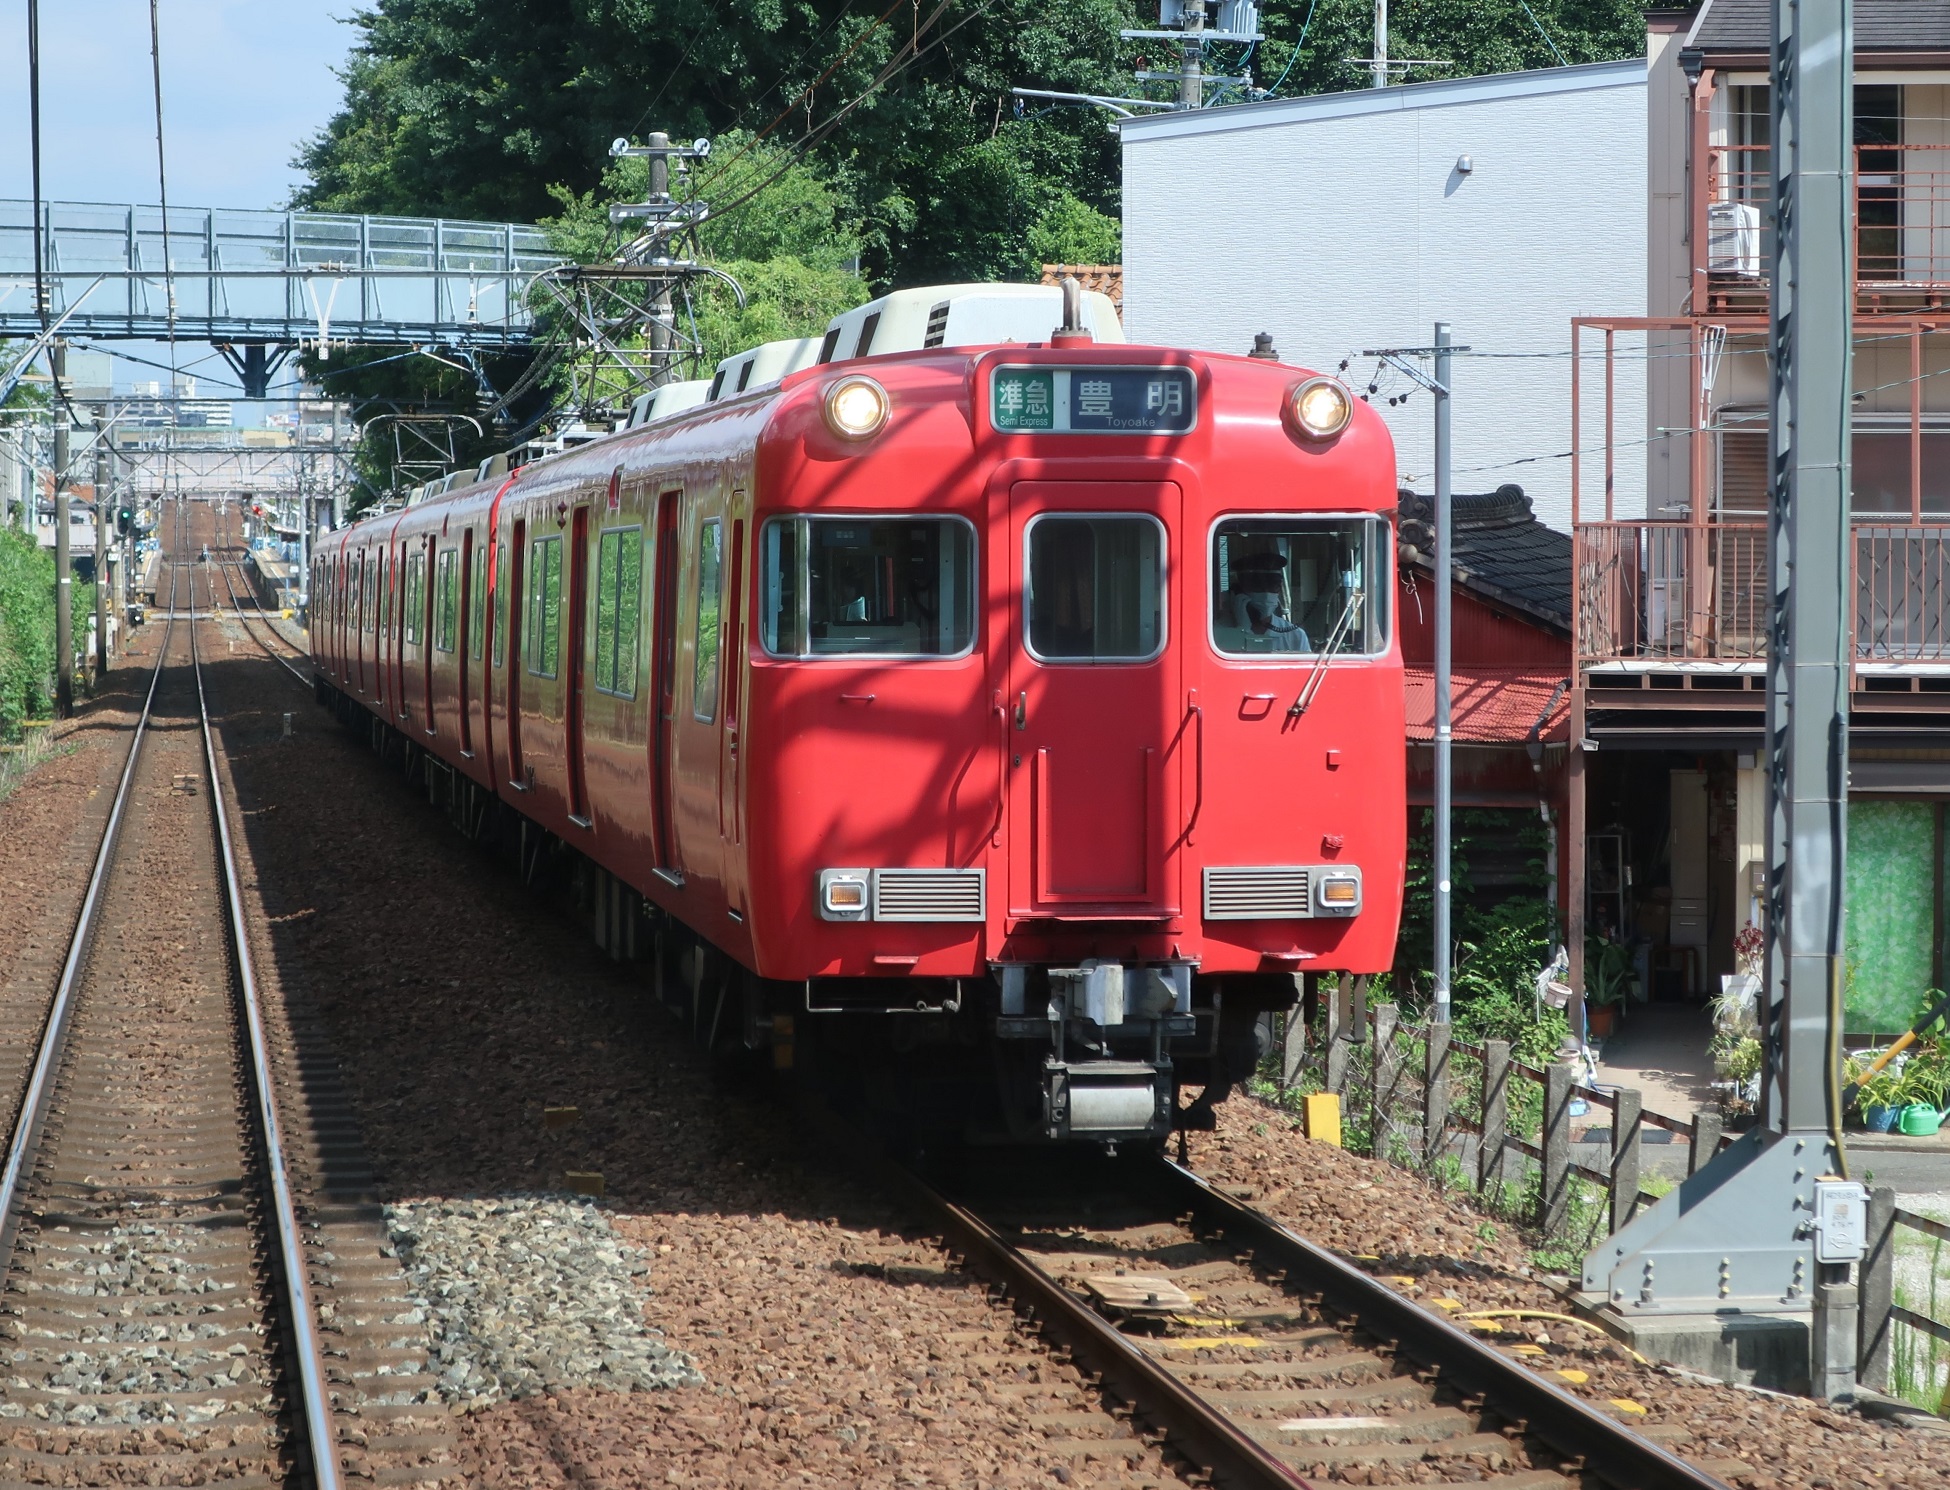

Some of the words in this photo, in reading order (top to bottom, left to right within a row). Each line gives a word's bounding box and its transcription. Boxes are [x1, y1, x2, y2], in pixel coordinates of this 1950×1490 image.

[999, 379, 1049, 415] 準急
[1078, 380, 1183, 416] 豊明
[1000, 416, 1018, 426] Semi
[1019, 416, 1048, 427] Express
[1105, 416, 1155, 428] Toyoake
